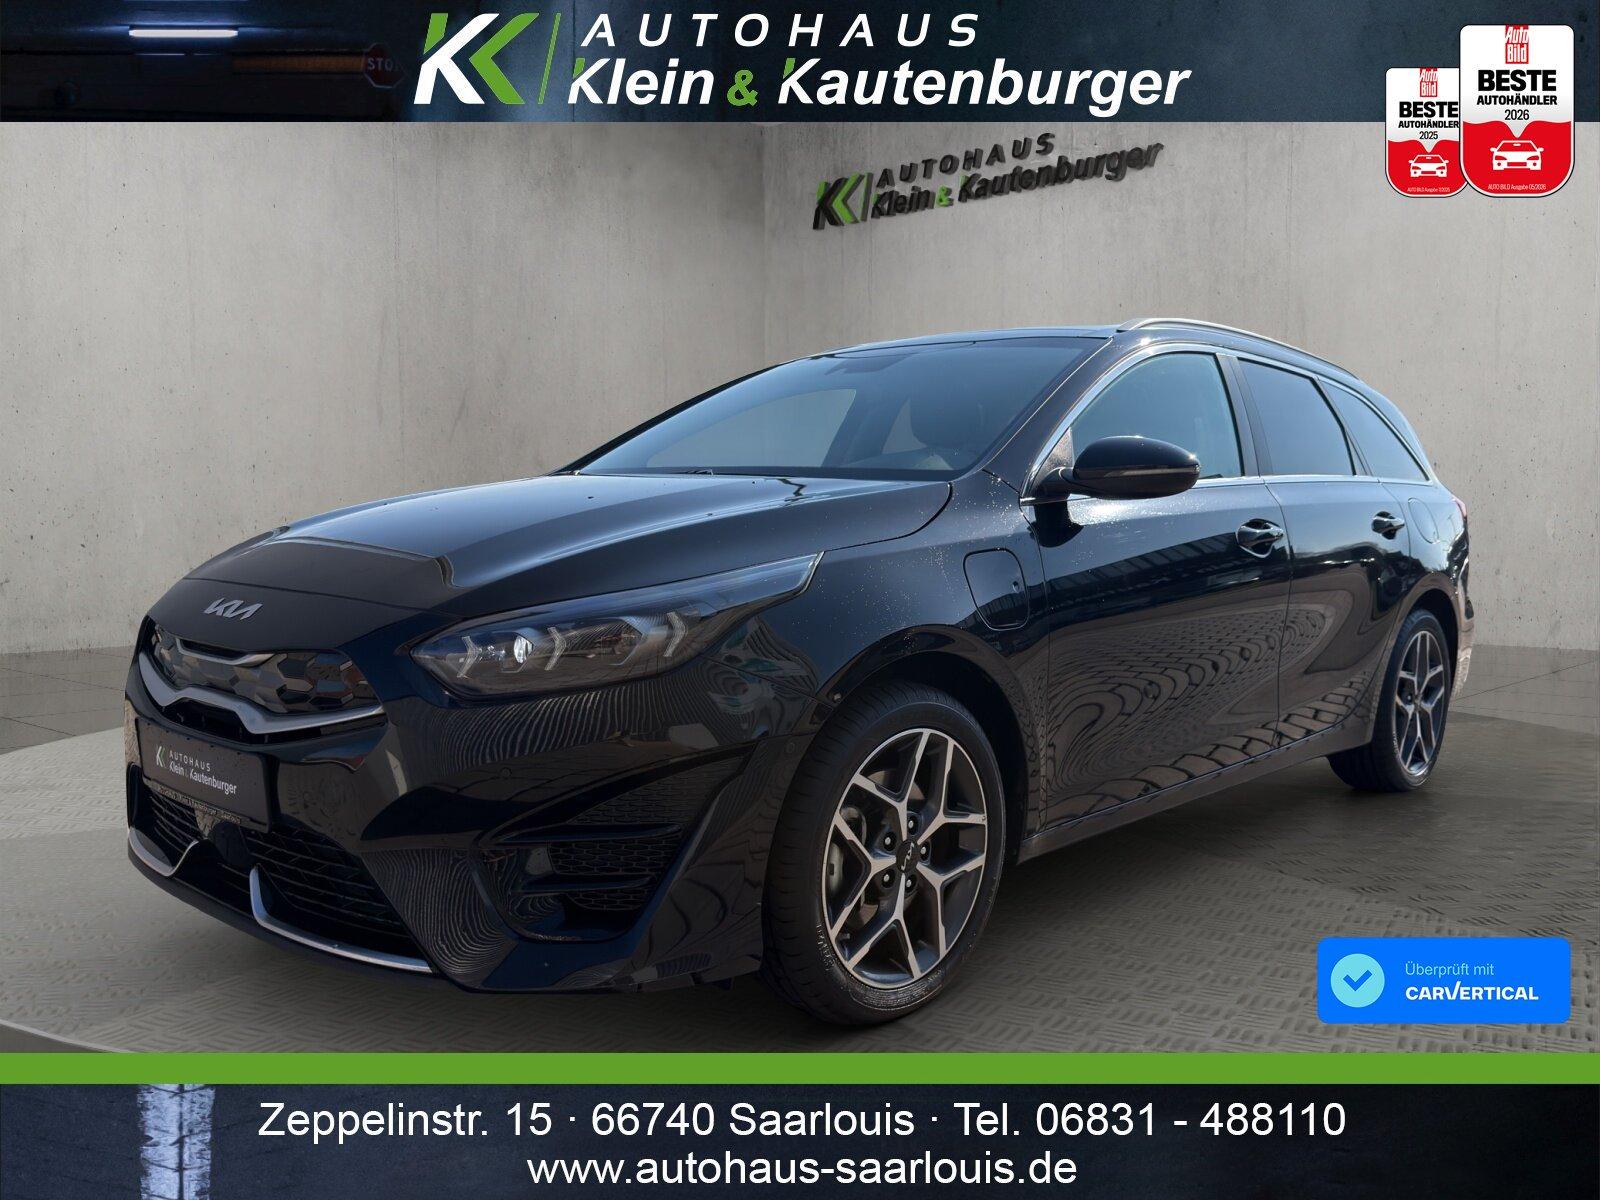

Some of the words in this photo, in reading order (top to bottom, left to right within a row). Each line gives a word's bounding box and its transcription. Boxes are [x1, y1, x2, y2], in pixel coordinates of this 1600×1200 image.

[871, 185, 936, 219] Klein
[935, 186, 953, 208] &
[958, 142, 1164, 203] Kautenburger
[876, 132, 1055, 189] AUTOHAUS
[169, 750, 211, 772] AUTOHAUS
[169, 761, 185, 776] Klein
[190, 769, 237, 795] Kautenburger
